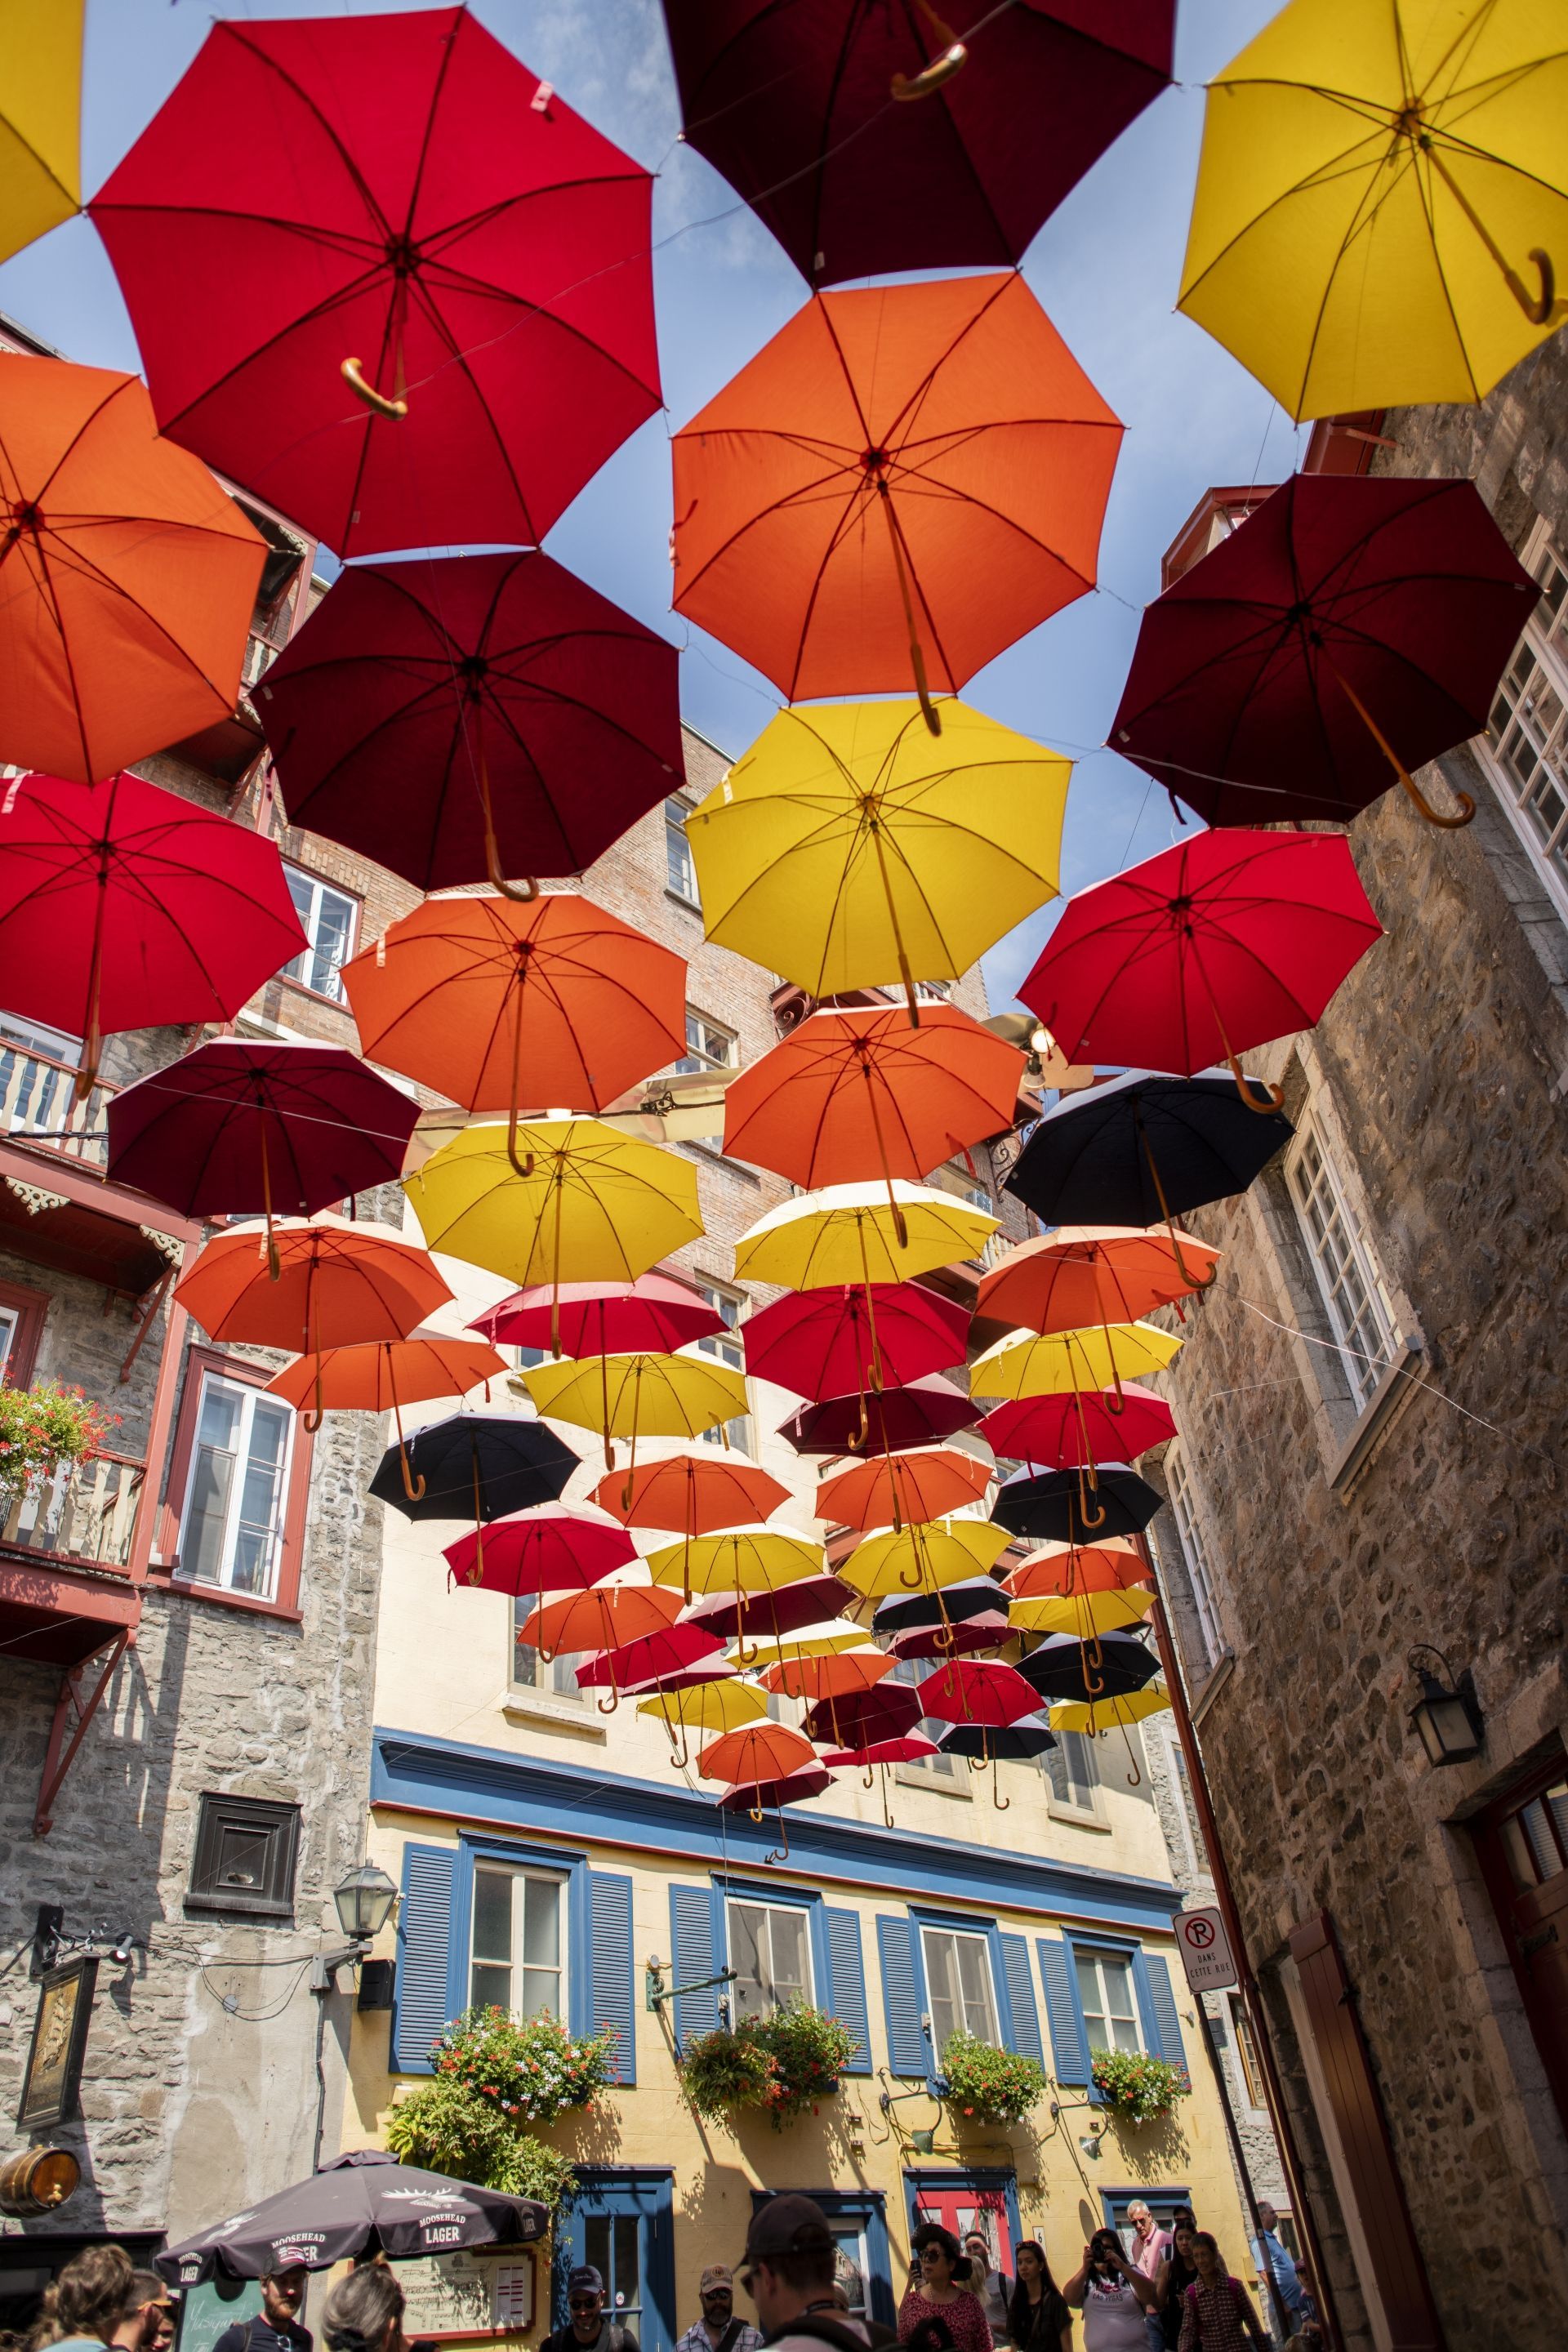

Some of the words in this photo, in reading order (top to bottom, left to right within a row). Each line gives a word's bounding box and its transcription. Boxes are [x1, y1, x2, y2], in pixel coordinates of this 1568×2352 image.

[1197, 1952, 1216, 1963] DANS
[1190, 1967, 1211, 1978] CETTE
[1214, 1962, 1230, 1974] RUE
[419, 2213, 466, 2228] MOOSEHEAD
[271, 2232, 326, 2249] MOOSEHEAD
[425, 2226, 460, 2244] LAGER
[1038, 2232, 1043, 2243] 6
[178, 2252, 203, 2265] MOOSEHEAD
[180, 2265, 198, 2283] LAGER
